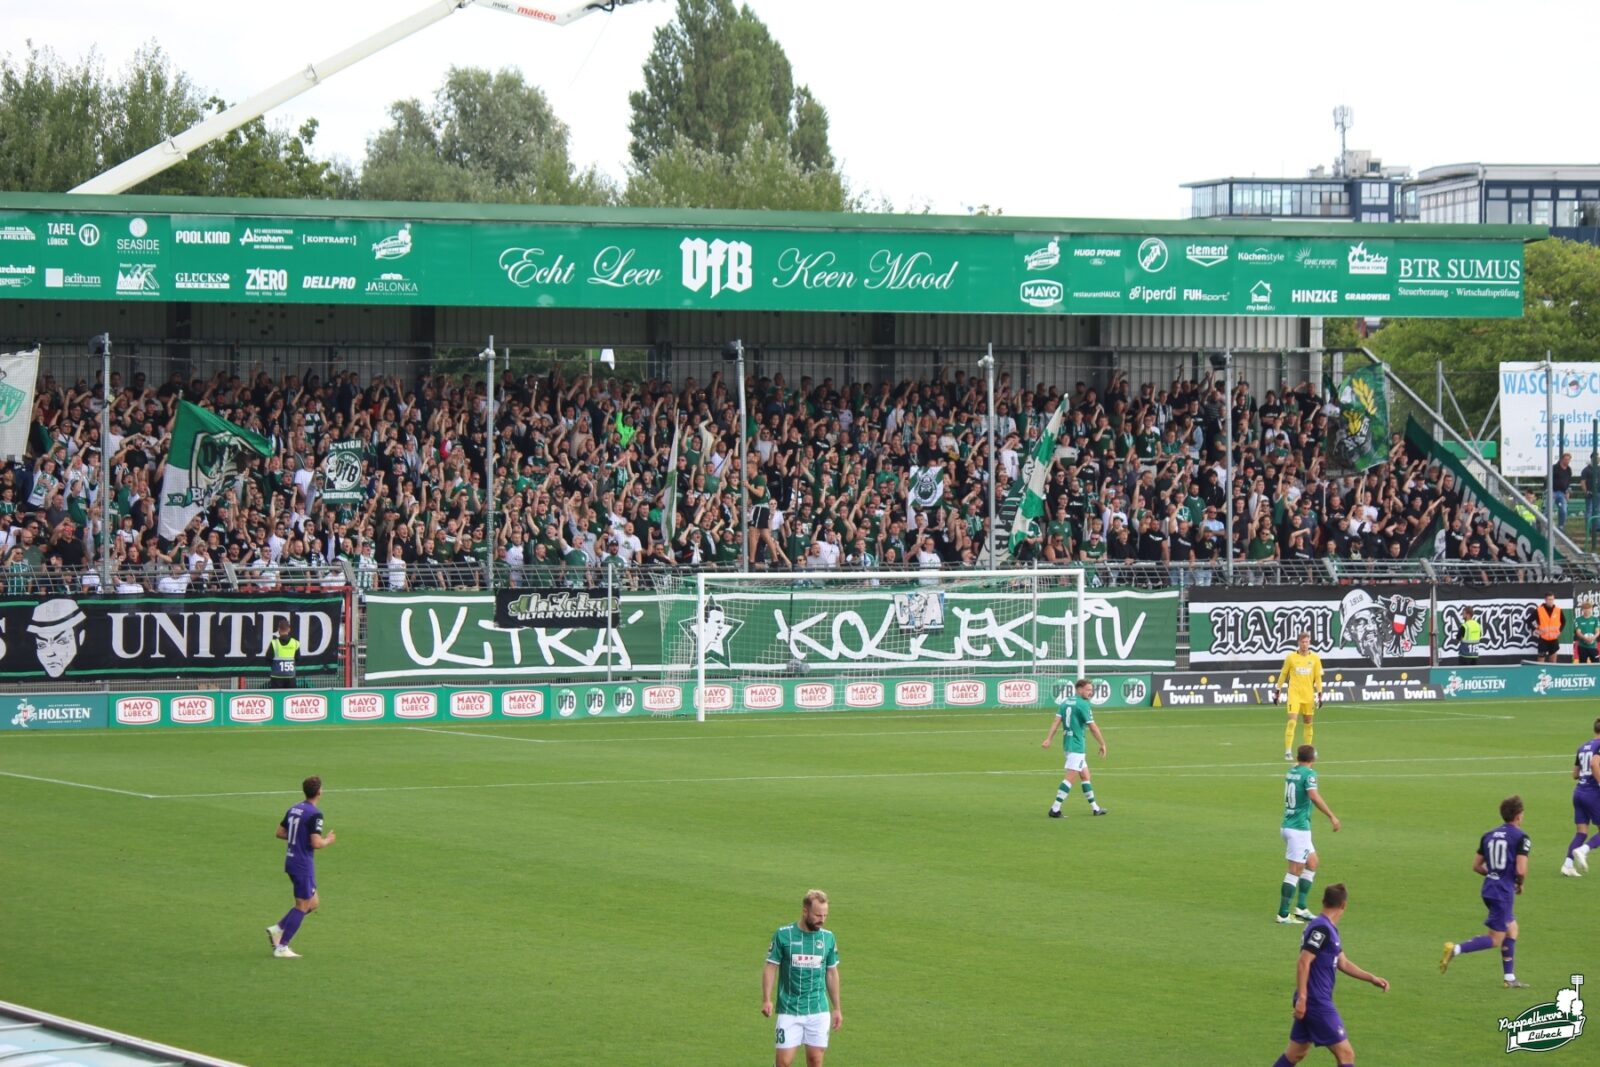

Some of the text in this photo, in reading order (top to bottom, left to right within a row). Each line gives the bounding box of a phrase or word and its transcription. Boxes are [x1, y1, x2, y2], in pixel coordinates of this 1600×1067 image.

[517, 5, 556, 22] mateco
[48, 223, 76, 236] TAFEL
[48, 237, 68, 246] LÜBECK
[240, 228, 284, 245] Abraham
[117, 239, 160, 250] SEASIDE
[1186, 244, 1228, 256] clement
[1238, 252, 1285, 262] Küchenstyle
[499, 245, 663, 287] Echt Leev
[772, 247, 959, 290] Keen Mood
[1399, 258, 1521, 280] BTR SUMUS
[302, 276, 356, 290] DELLPRO
[365, 282, 418, 292] JABLONKA
[1024, 286, 1059, 298] MAYO
[1142, 286, 1176, 303] iperdi
[1292, 290, 1338, 303] HINZKE
[1344, 292, 1390, 301] GRABOWSKI
[1398, 287, 1520, 300] Steuerberatung Wirtschaftsprüfung
[517, 611, 552, 620] ULTRA
[556, 610, 593, 618] YOUTH
[280, 661, 294, 672] 155
[1464, 679, 1506, 690] HOLSTEN
[1554, 677, 1596, 688] HOLSTEN
[750, 688, 776, 696] MAYO
[1124, 684, 1144, 698] VfB
[1214, 690, 1247, 703] bwin
[1362, 688, 1394, 700] bwin
[1404, 687, 1436, 699] bwin
[402, 696, 430, 704] MAYO
[458, 694, 485, 703] MAYO
[509, 694, 536, 702] MAYO
[558, 694, 574, 710] VfB
[587, 694, 602, 708] VfB
[614, 692, 632, 706] VfB
[1170, 691, 1204, 704] bwin
[178, 700, 207, 708] MAYO
[291, 706, 319, 714] LÜBECK
[349, 705, 376, 713] LÜBECK
[402, 704, 429, 712] LÜBECK
[38, 708, 91, 720] HOLSTEN
[178, 708, 206, 716] LÜBECK
[288, 816, 300, 845] 11
[1488, 839, 1507, 870] 10
